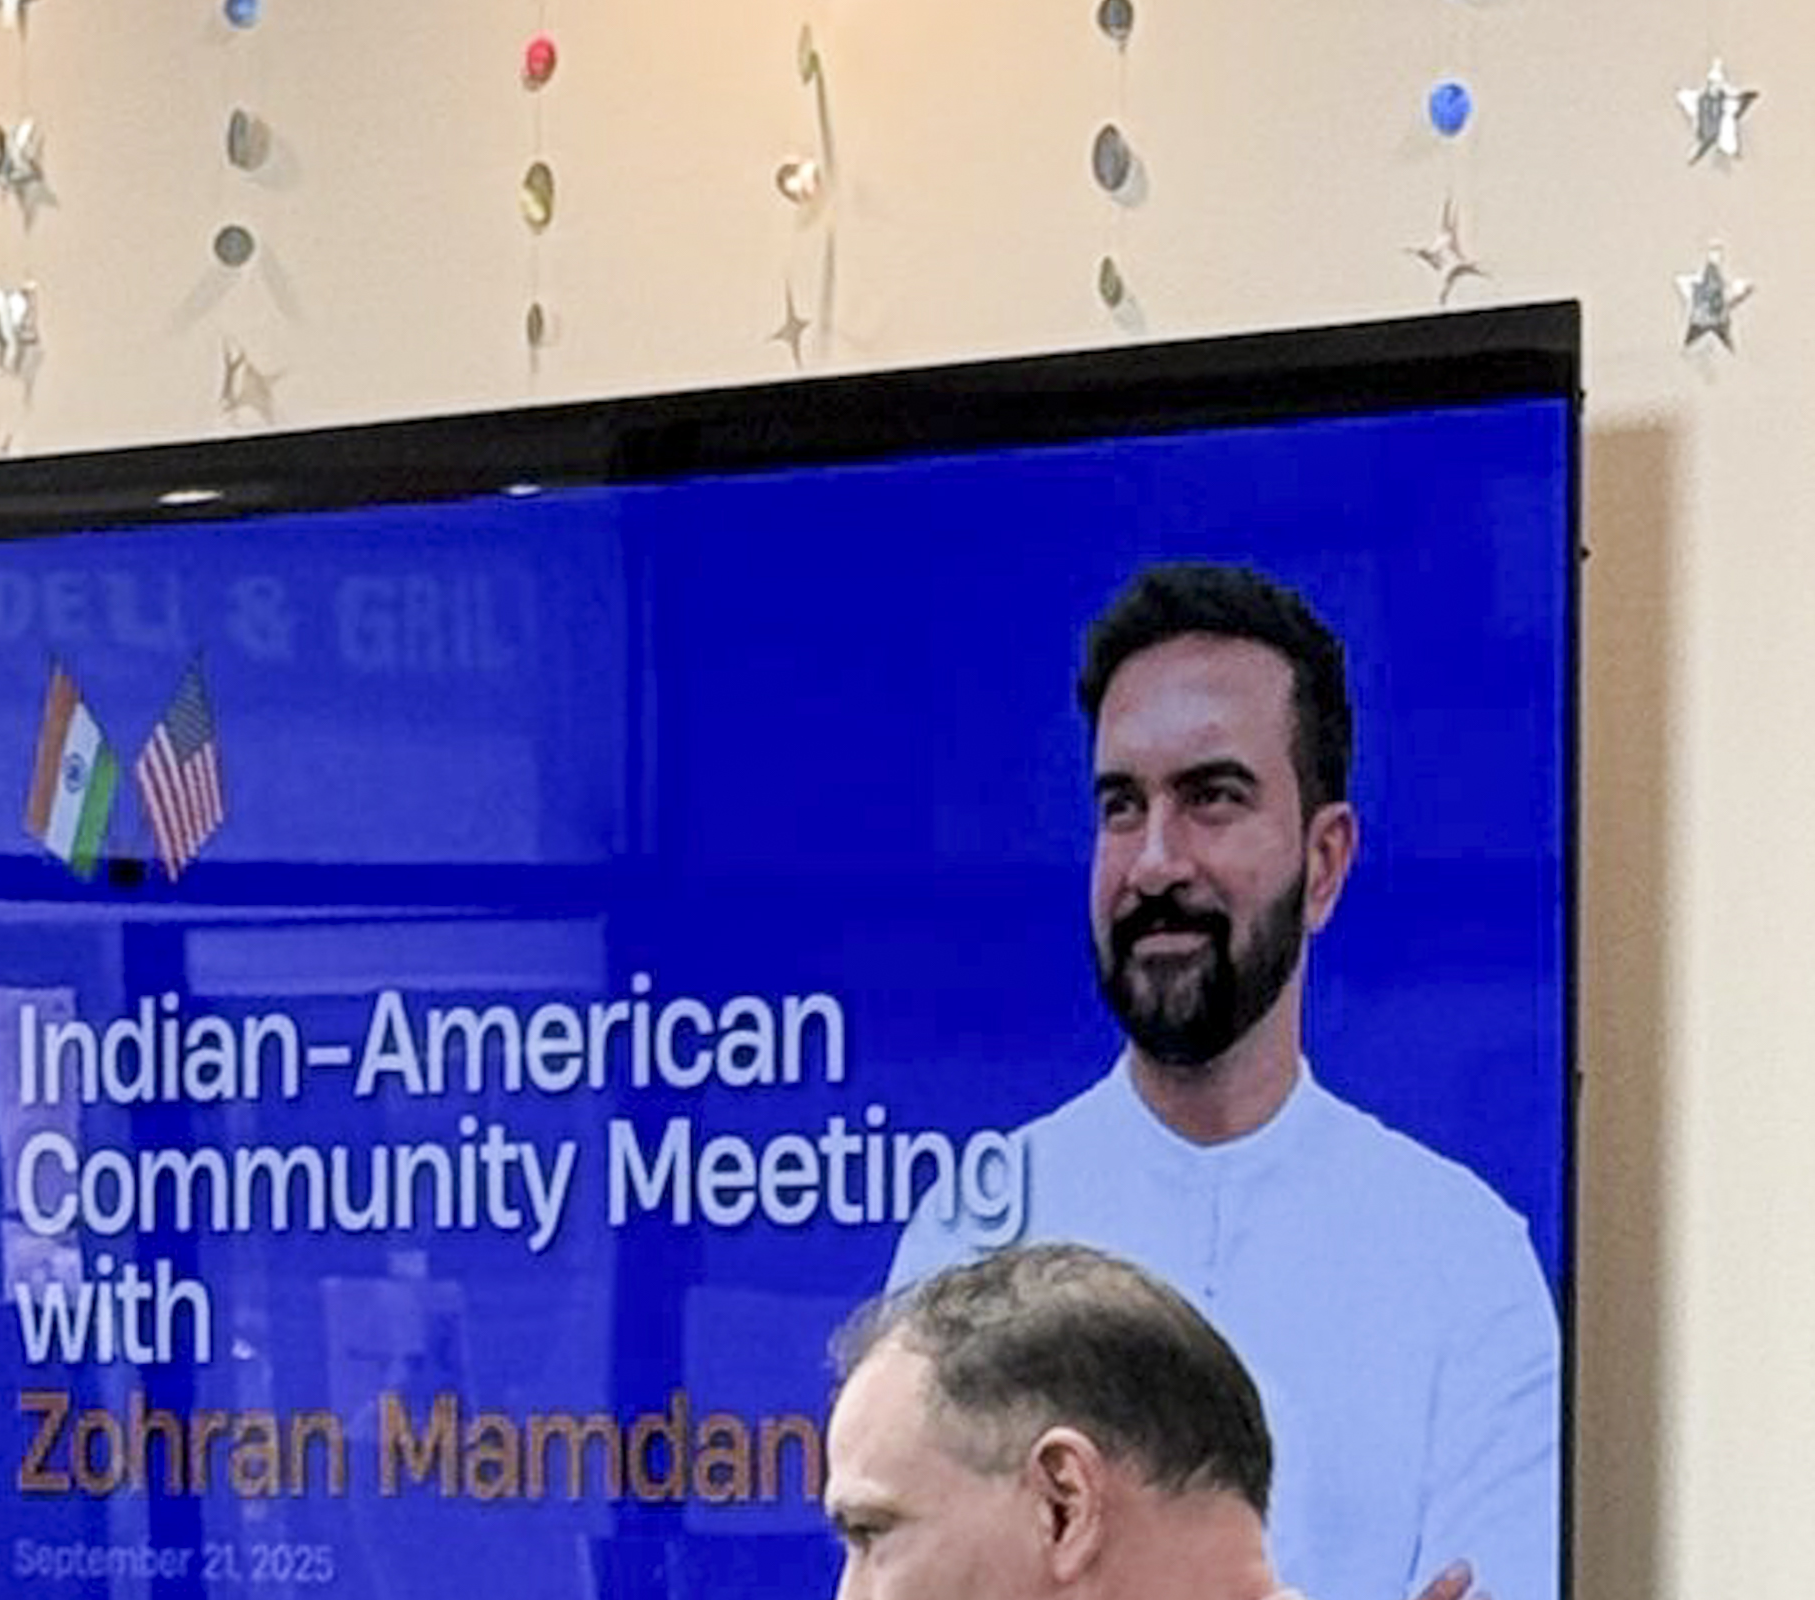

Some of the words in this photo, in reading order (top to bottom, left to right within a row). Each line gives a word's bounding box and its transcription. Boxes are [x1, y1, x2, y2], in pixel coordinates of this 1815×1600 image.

[225, 574, 292, 663] &
[18, 972, 845, 1105] Indian-American
[16, 1115, 576, 1253] Community
[608, 1104, 1027, 1248] Meeting
[15, 1255, 213, 1365] with
[17, 1388, 346, 1499] Zohran
[377, 1388, 823, 1502] Mamdan
[13, 1537, 196, 1581] September
[251, 1543, 335, 1583] 2025
